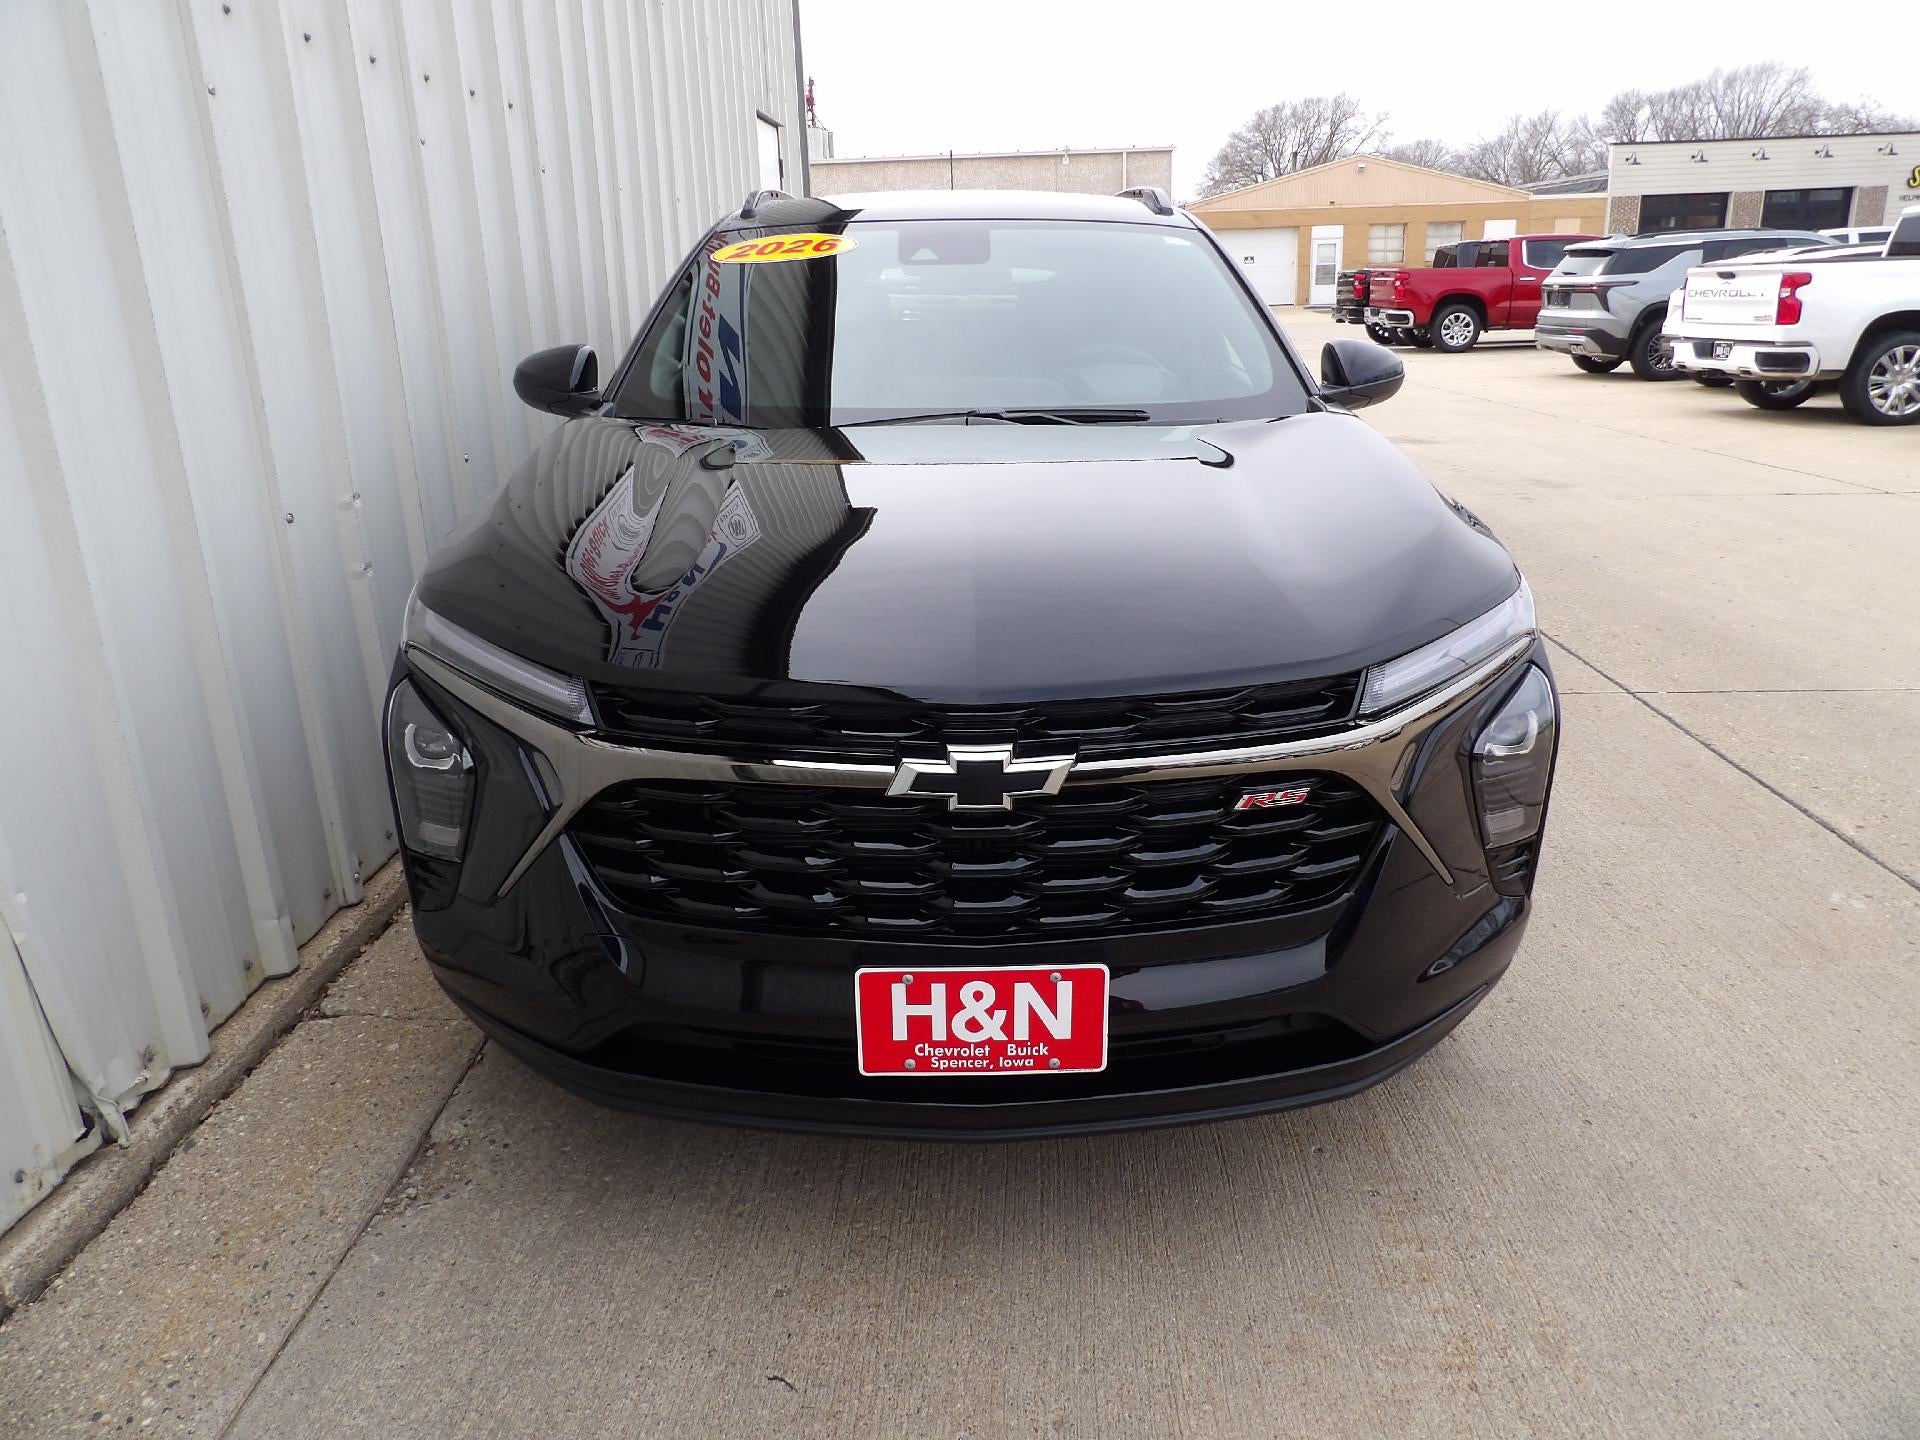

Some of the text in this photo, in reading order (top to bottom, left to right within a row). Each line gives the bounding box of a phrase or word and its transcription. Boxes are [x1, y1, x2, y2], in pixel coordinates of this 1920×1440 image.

[725, 239, 842, 260] 2026
[1234, 787, 1310, 810] RS
[891, 980, 1073, 1042] H&N
[914, 1042, 1049, 1057] Chevrolet Buick
[931, 1057, 1034, 1070] Spencer, Iowa
